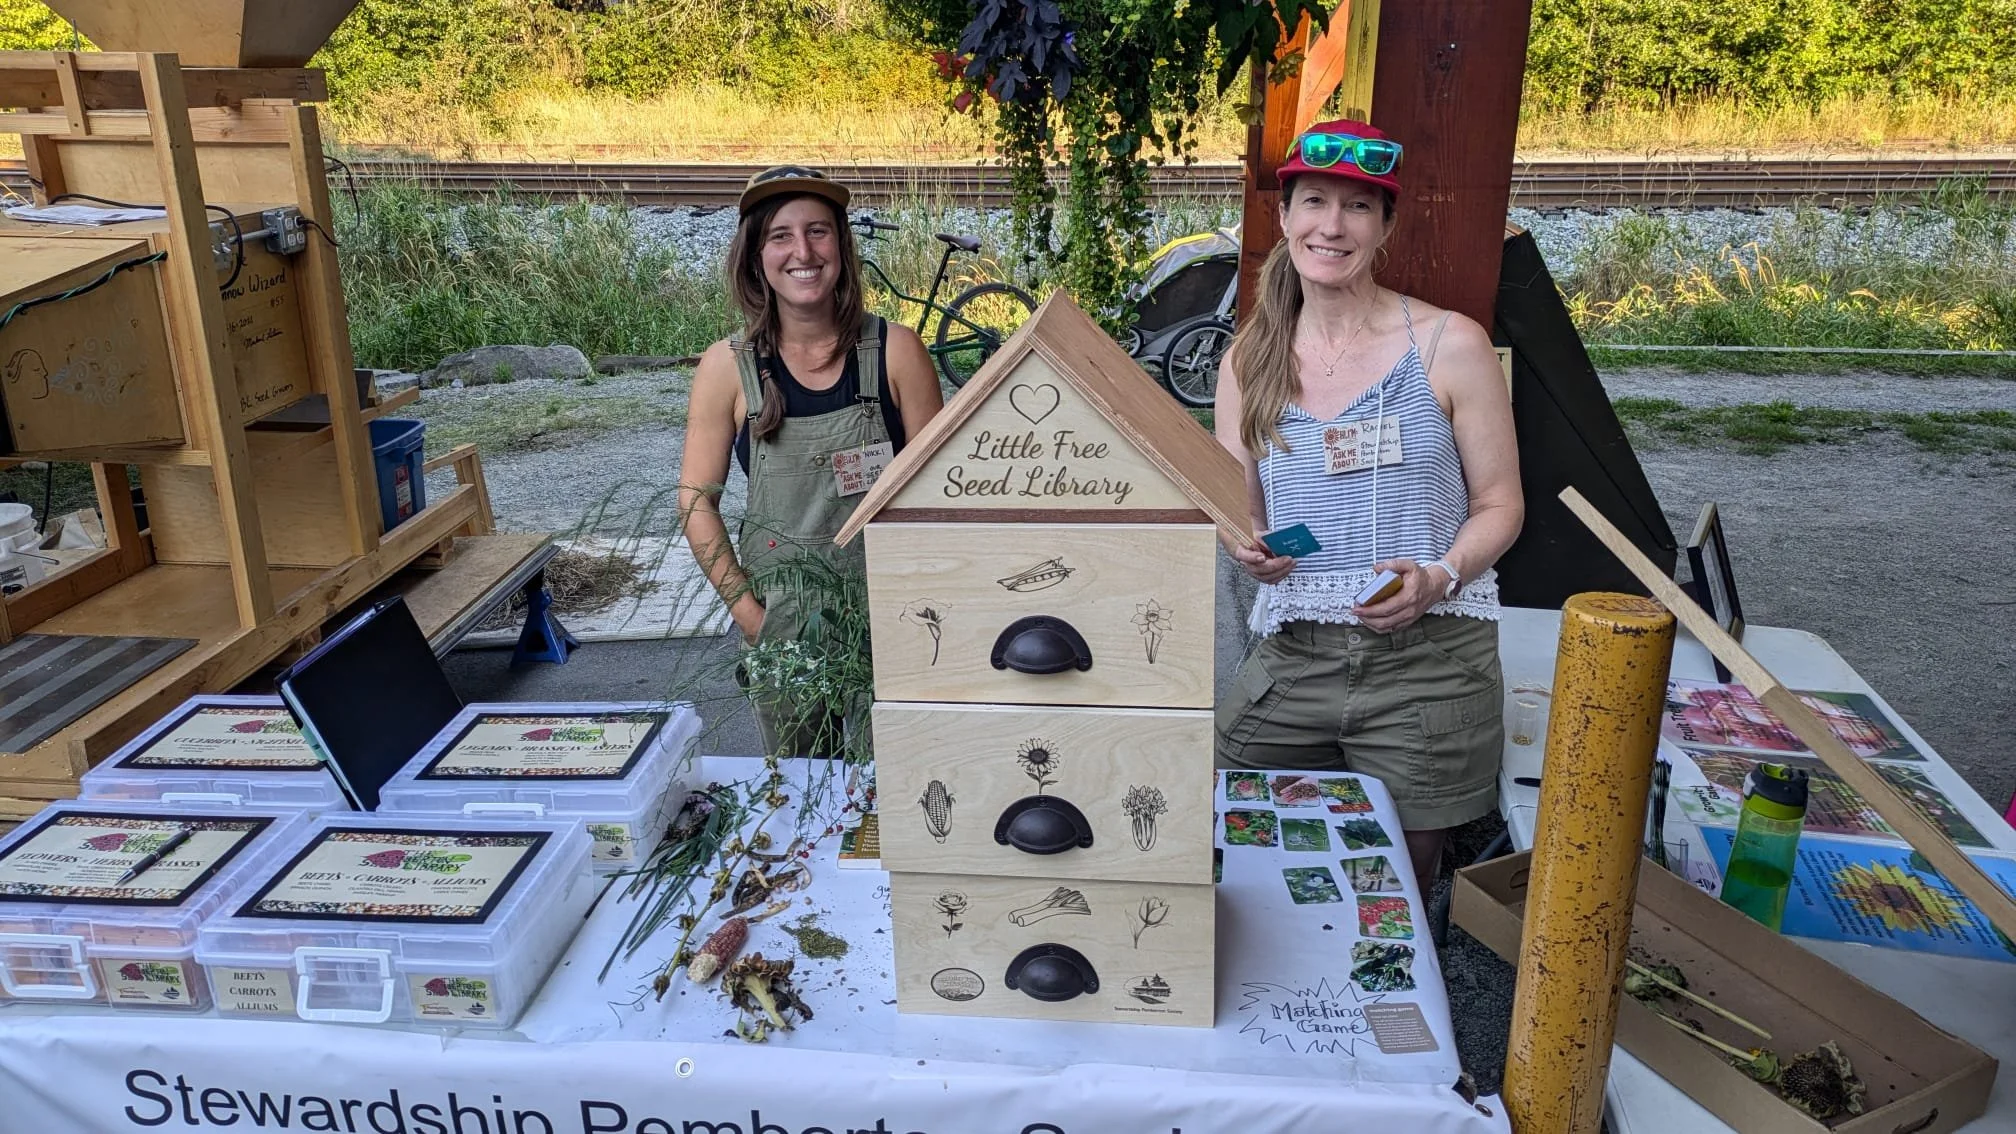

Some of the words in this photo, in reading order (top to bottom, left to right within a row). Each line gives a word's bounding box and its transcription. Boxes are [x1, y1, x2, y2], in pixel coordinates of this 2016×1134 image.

[221, 287, 245, 301] nnow
[248, 267, 287, 293] Wizard
[967, 430, 1044, 461] Little
[1053, 430, 1110, 461] Free
[1333, 450, 1347, 460] ASK
[1347, 448, 1357, 458] ME
[944, 465, 1012, 498] Seed
[1018, 465, 1133, 505] Library
[1676, 722, 1699, 742] Fruit
[16, 852, 81, 863] FLOWERS
[88, 857, 137, 866] HERBS
[152, 860, 204, 868] RASSES
[300, 871, 344, 881] BEETS
[353, 873, 418, 885] CARROTS
[429, 876, 492, 886] ALLIUMS
[233, 971, 265, 981] BEETS
[229, 986, 277, 997] CARROTS
[234, 1002, 279, 1011] ALLIUMS
[1271, 999, 1366, 1028] Matching
[1297, 1019, 1360, 1034] Game
